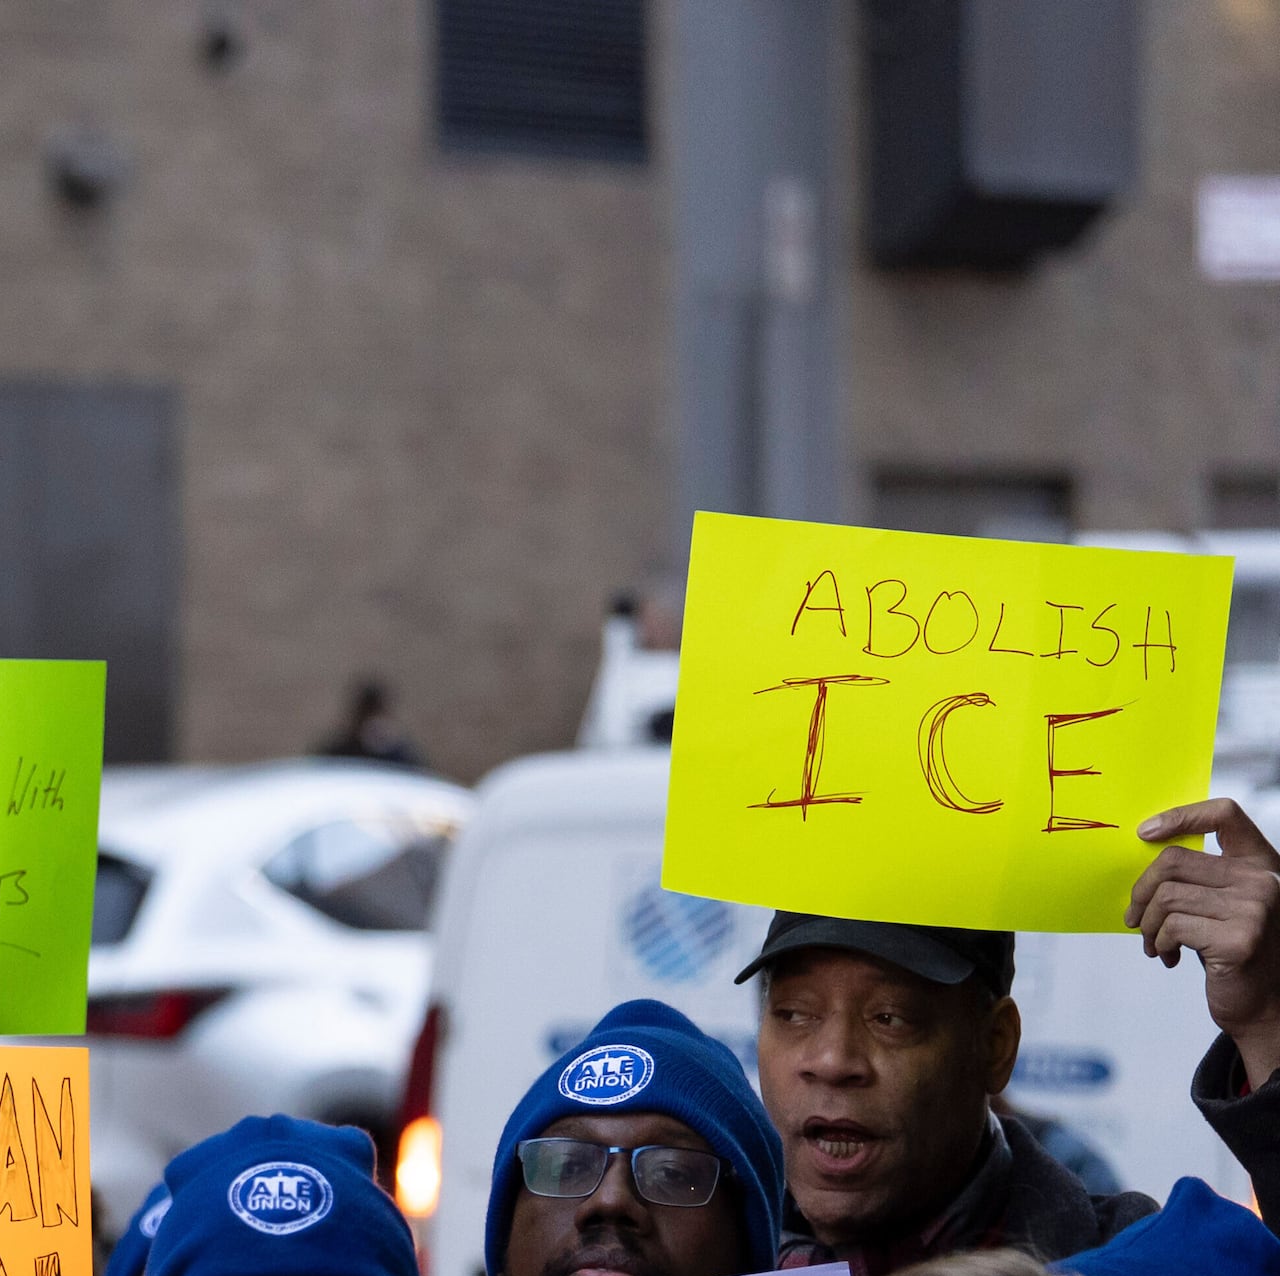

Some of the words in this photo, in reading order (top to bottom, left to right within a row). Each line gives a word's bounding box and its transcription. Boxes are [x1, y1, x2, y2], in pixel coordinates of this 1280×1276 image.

[791, 569, 1178, 680] ABOLISH
[747, 674, 1138, 834] ICE
[7, 756, 65, 816] With
[576, 1059, 635, 1082] ALE
[574, 1075, 633, 1092] UNION
[249, 1179, 313, 1200] ALE
[247, 1200, 311, 1212] UNION
